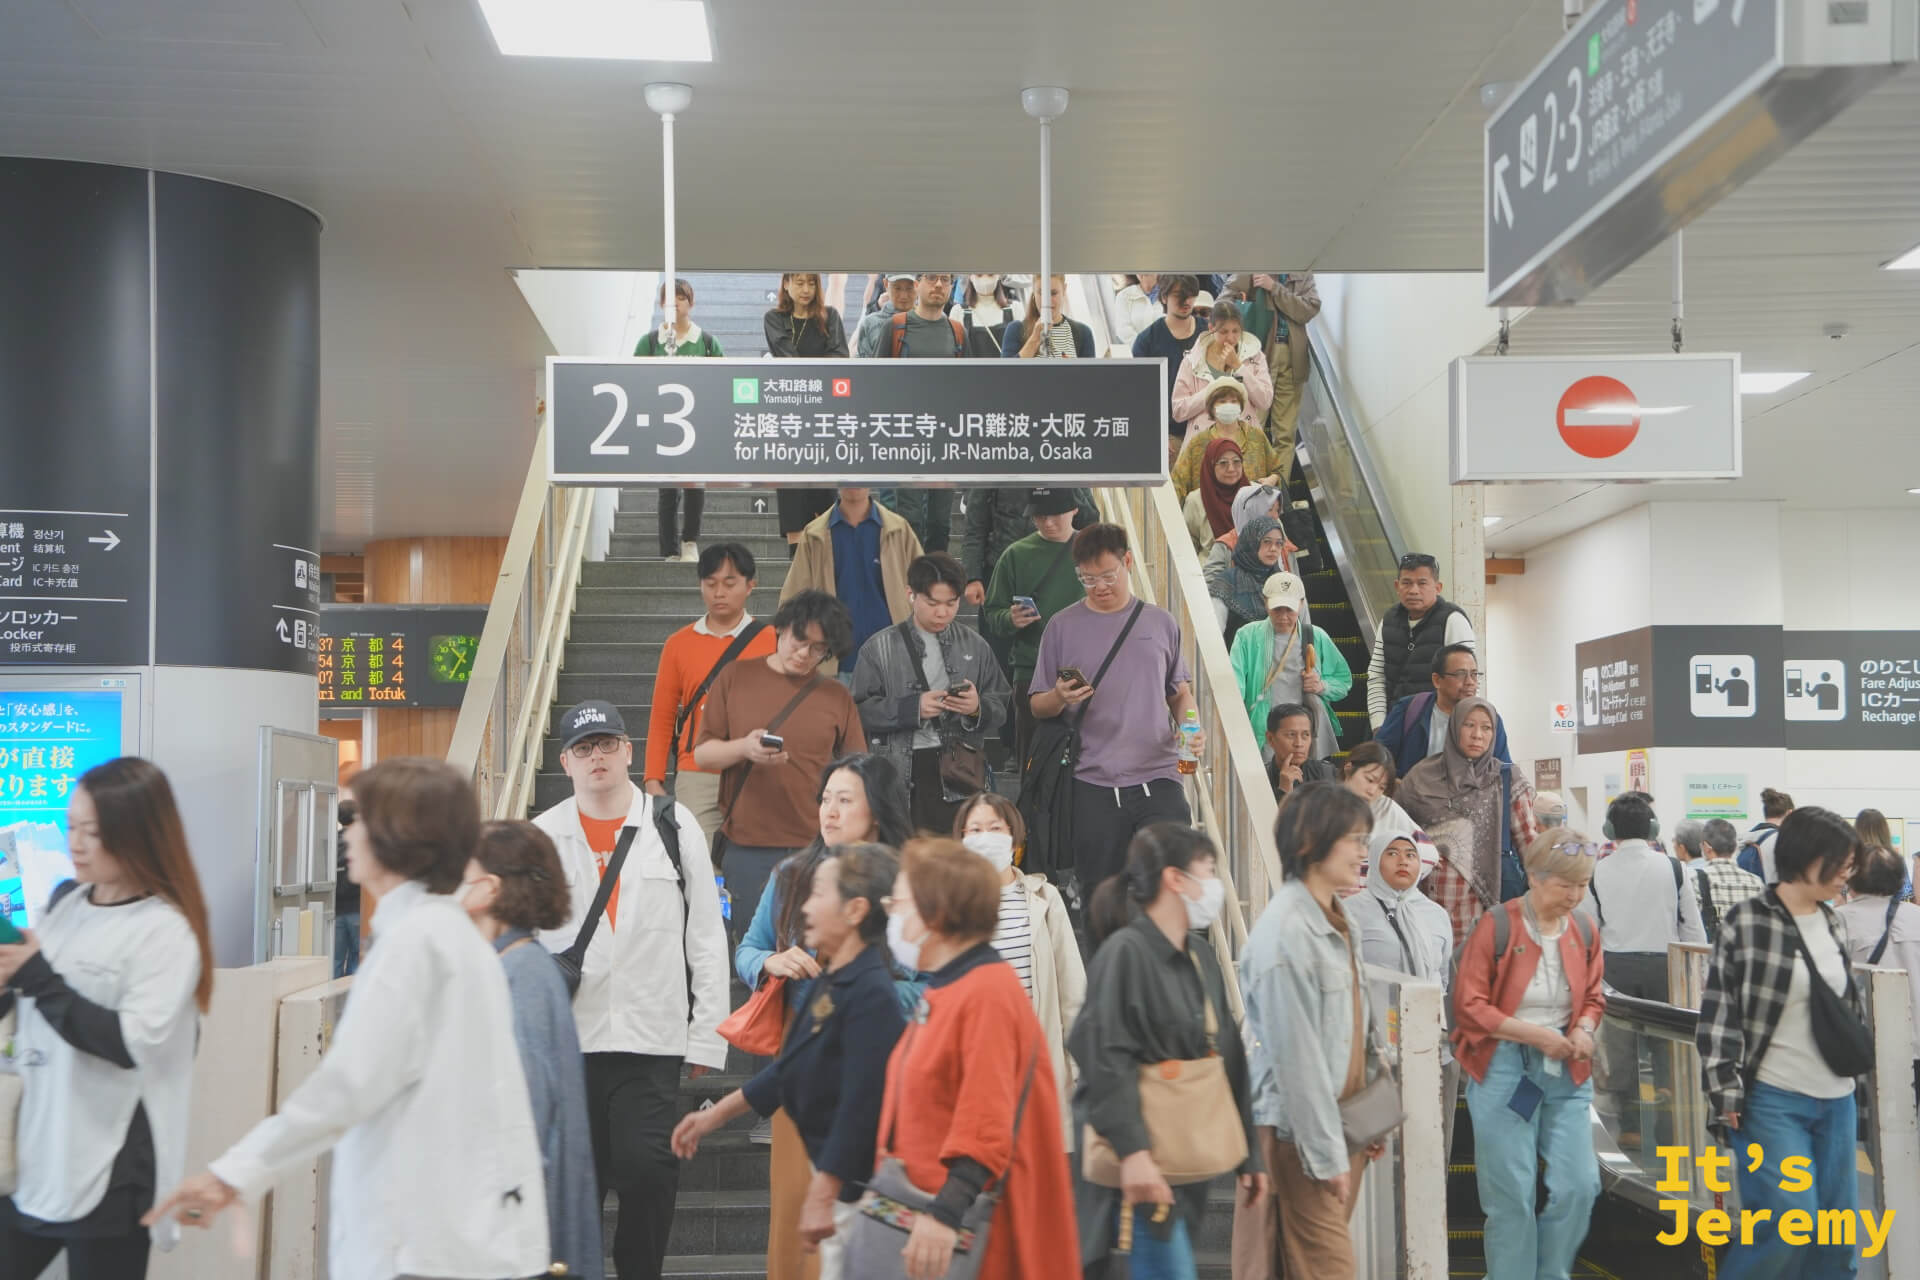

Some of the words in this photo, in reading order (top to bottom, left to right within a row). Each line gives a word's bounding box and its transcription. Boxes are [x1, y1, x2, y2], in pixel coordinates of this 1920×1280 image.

[763, 379, 823, 393] 大和路線
[835, 381, 848, 394] O
[764, 394, 801, 406] Yamatoji
[803, 394, 823, 404] Line
[1093, 416, 1130, 438] 方面
[734, 442, 759, 461] for
[869, 443, 936, 465] Tennōji,
[941, 442, 1034, 463] JR-Namba,
[1039, 440, 1093, 460] Ōsaka
[391, 637, 405, 652] 4
[391, 654, 405, 669] 4
[391, 670, 405, 685] 4
[1861, 677, 1886, 689] Fare
[341, 687, 363, 700] and
[368, 687, 406, 700] Tofuk
[573, 713, 607, 729] JAPAN
[1554, 720, 1575, 729] AED
[1862, 709, 1916, 725] Recharge
